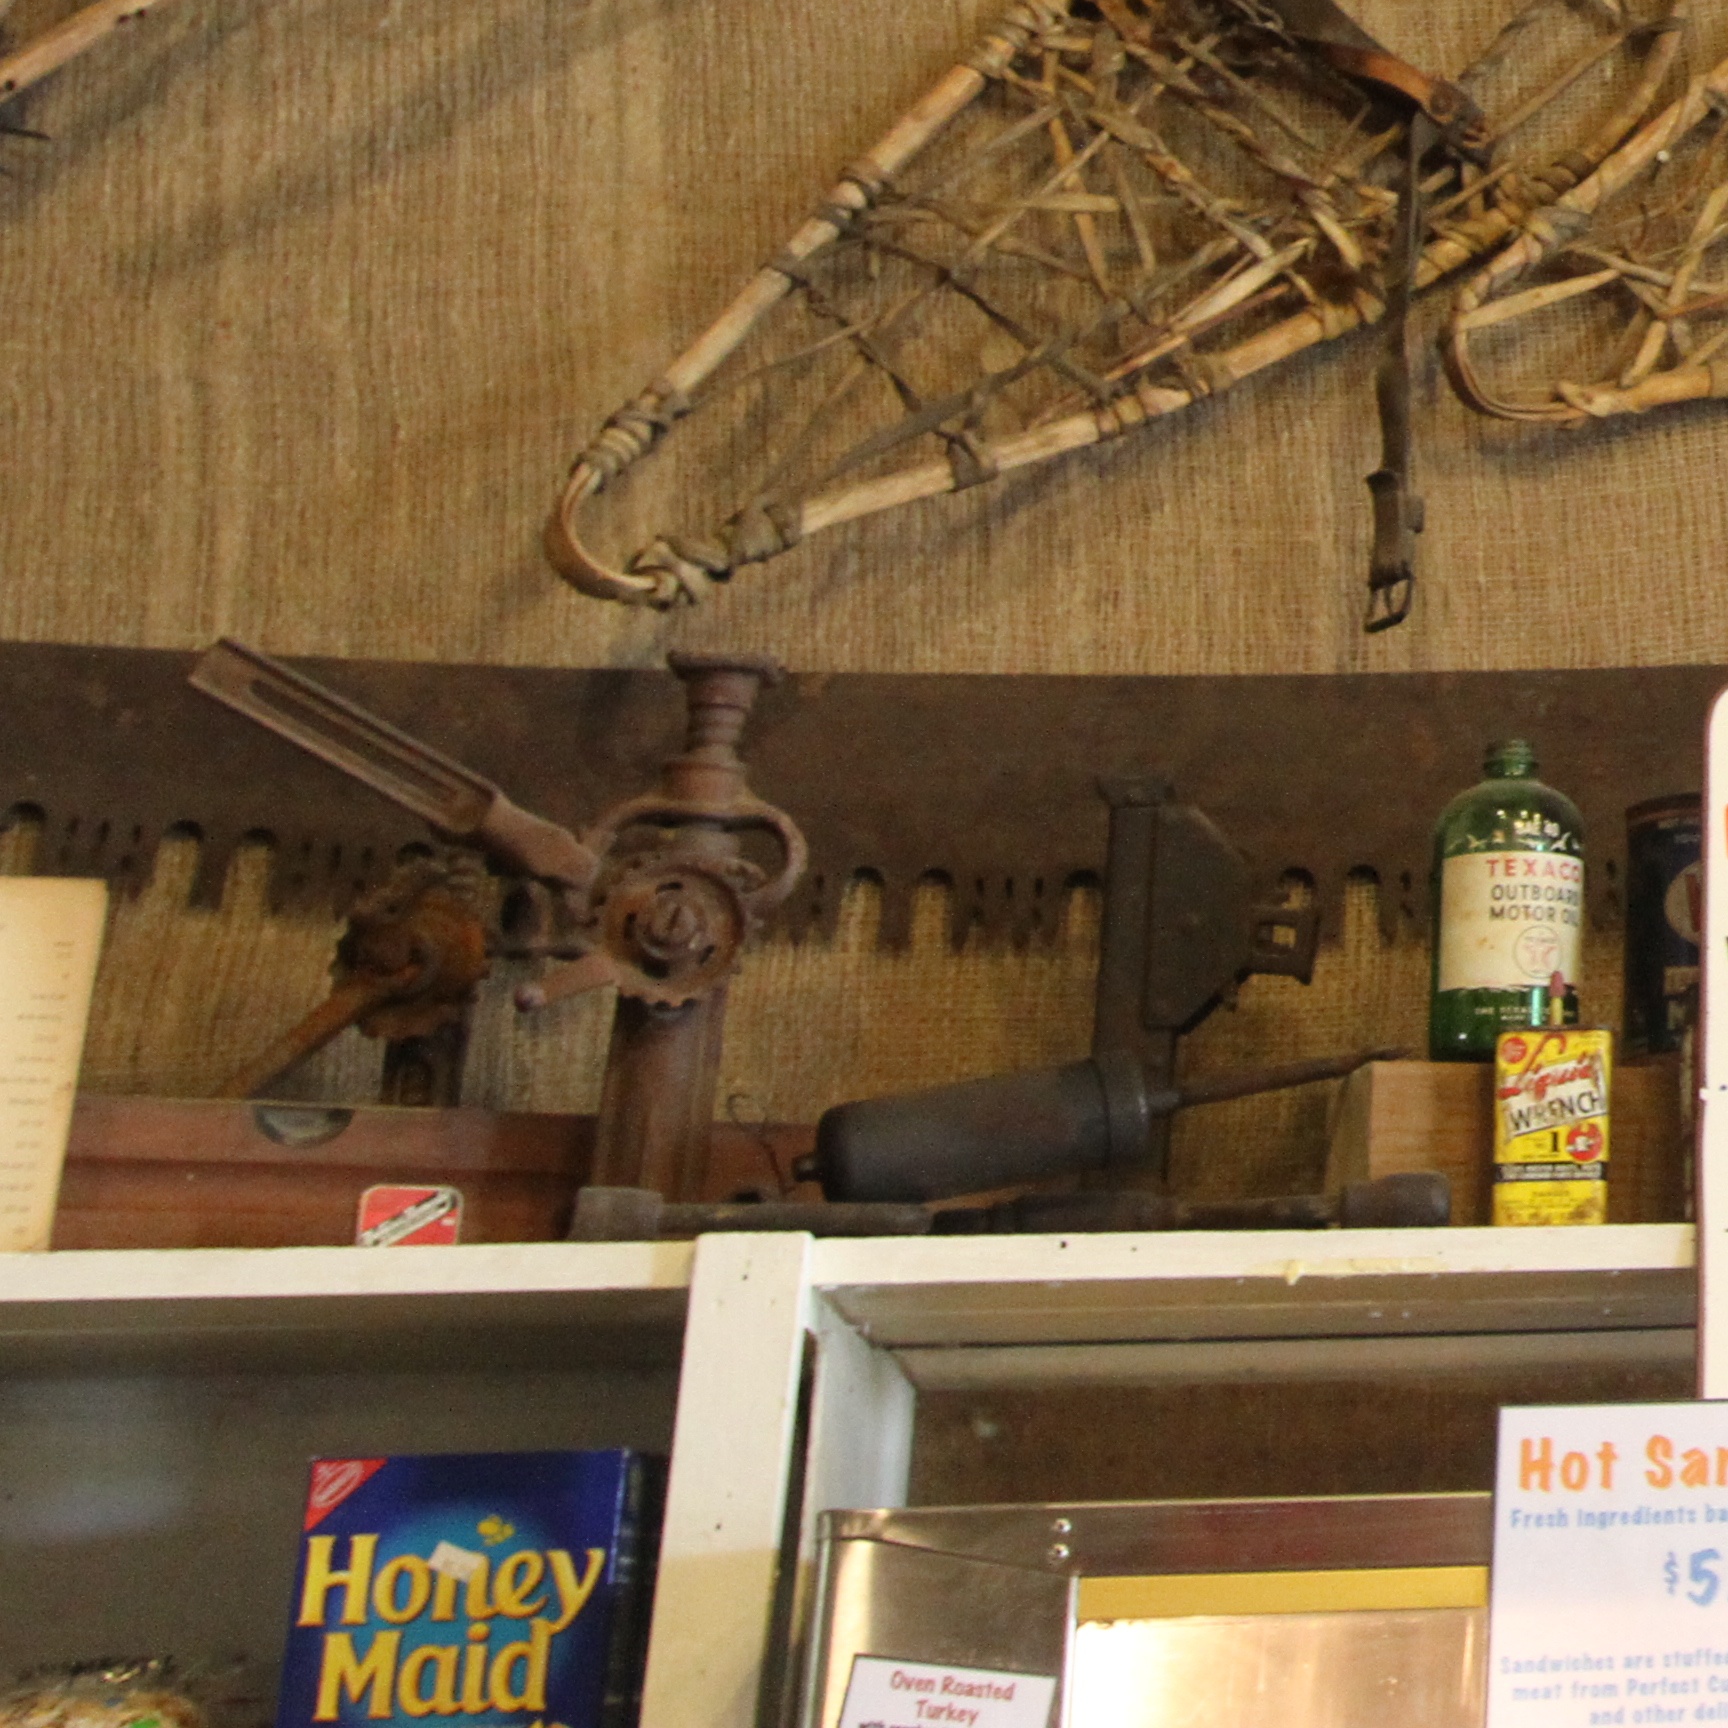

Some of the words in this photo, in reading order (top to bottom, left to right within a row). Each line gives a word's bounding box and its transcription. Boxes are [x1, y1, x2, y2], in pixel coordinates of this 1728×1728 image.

[1489, 904, 1556, 922] MOTOR
[1509, 1091, 1604, 1131] WRENCH
[1518, 1436, 1619, 1493] Hot
[1510, 1508, 1568, 1528] Fresh
[296, 1532, 606, 1637] Honey
[312, 1617, 553, 1722] Maid
[1499, 1653, 1615, 1675] Sandwiches
[1623, 1654, 1655, 1670] are
[890, 1670, 935, 1693] Oven
[941, 1675, 1017, 1701] Roasted
[1512, 1682, 1563, 1702] meat
[1571, 1680, 1619, 1700] from
[1626, 1676, 1700, 1698] Perfect
[916, 1699, 981, 1724] Turkey
[1590, 1706, 1625, 1726] and
[1633, 1703, 1685, 1724] other
